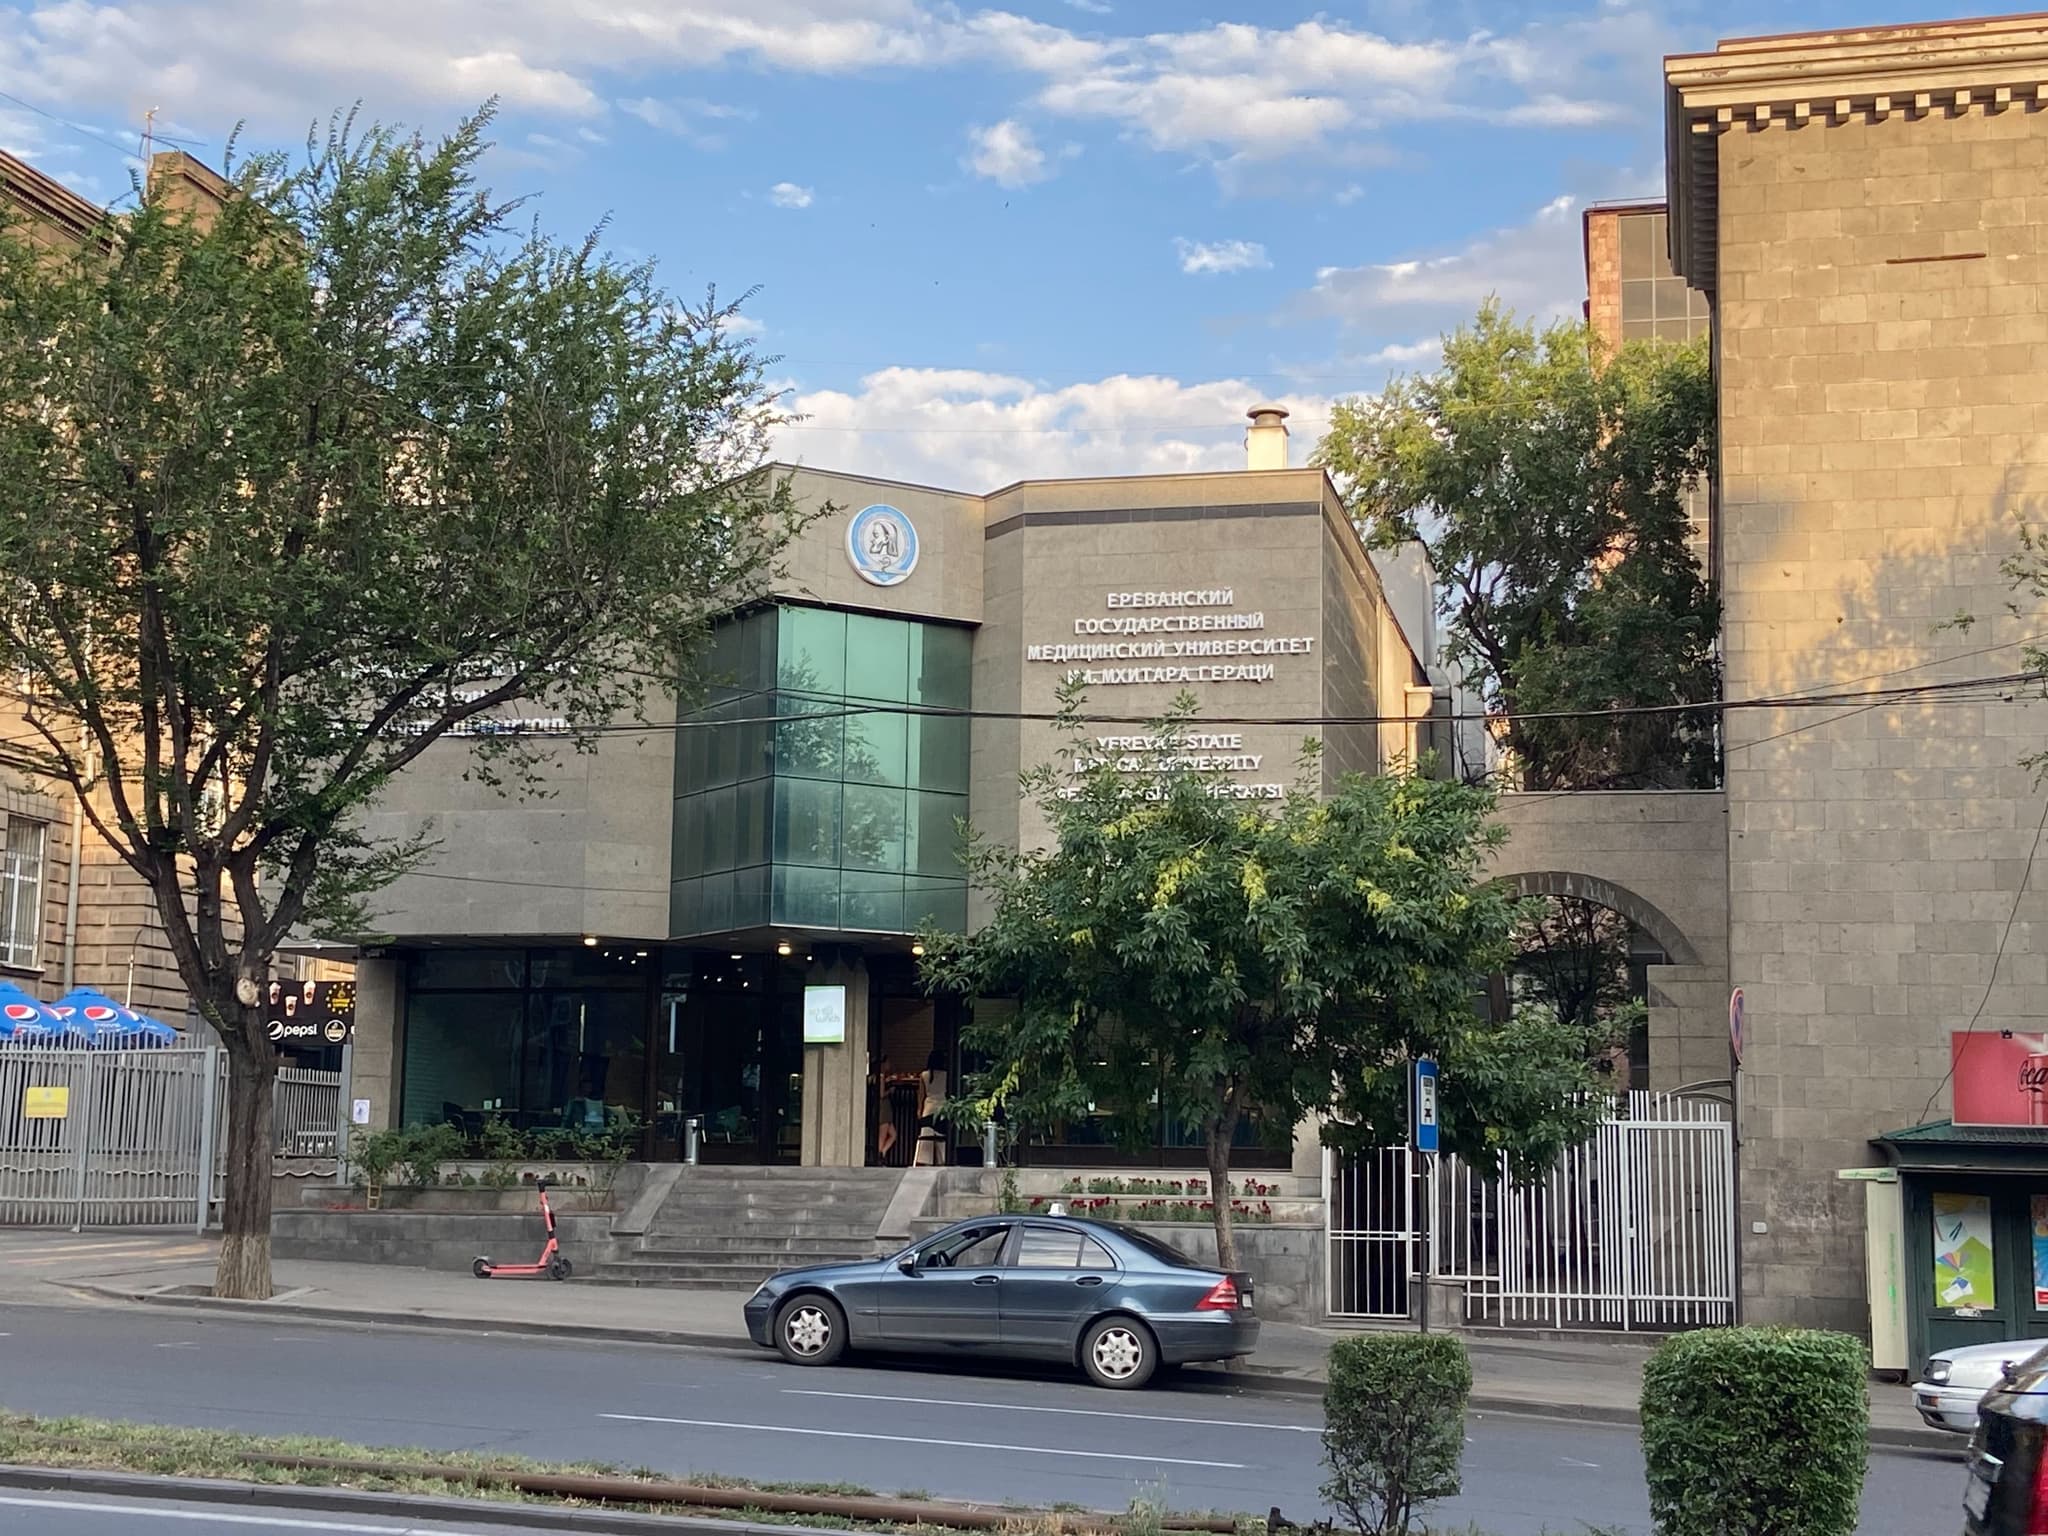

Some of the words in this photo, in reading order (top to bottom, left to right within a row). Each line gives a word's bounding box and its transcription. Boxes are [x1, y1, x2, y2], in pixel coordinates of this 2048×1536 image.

[1107, 587, 1234, 608] ЕРЕВАНСКИЙ
[1074, 611, 1264, 636] ГОСУДАРСТВЕННЫЙ
[1027, 639, 1165, 662] МЕДИЦИНСКИЙ
[1174, 637, 1314, 656] УНИВЕРСИТЕТ
[1102, 667, 1189, 684] МХИТАРА
[1198, 664, 1274, 683] ГЕРАЦИ
[1096, 735, 1185, 751] YEREVA
[1187, 734, 1242, 749] STATE
[1074, 757, 1152, 772] MECAL
[283, 1023, 318, 1038] pepsi
